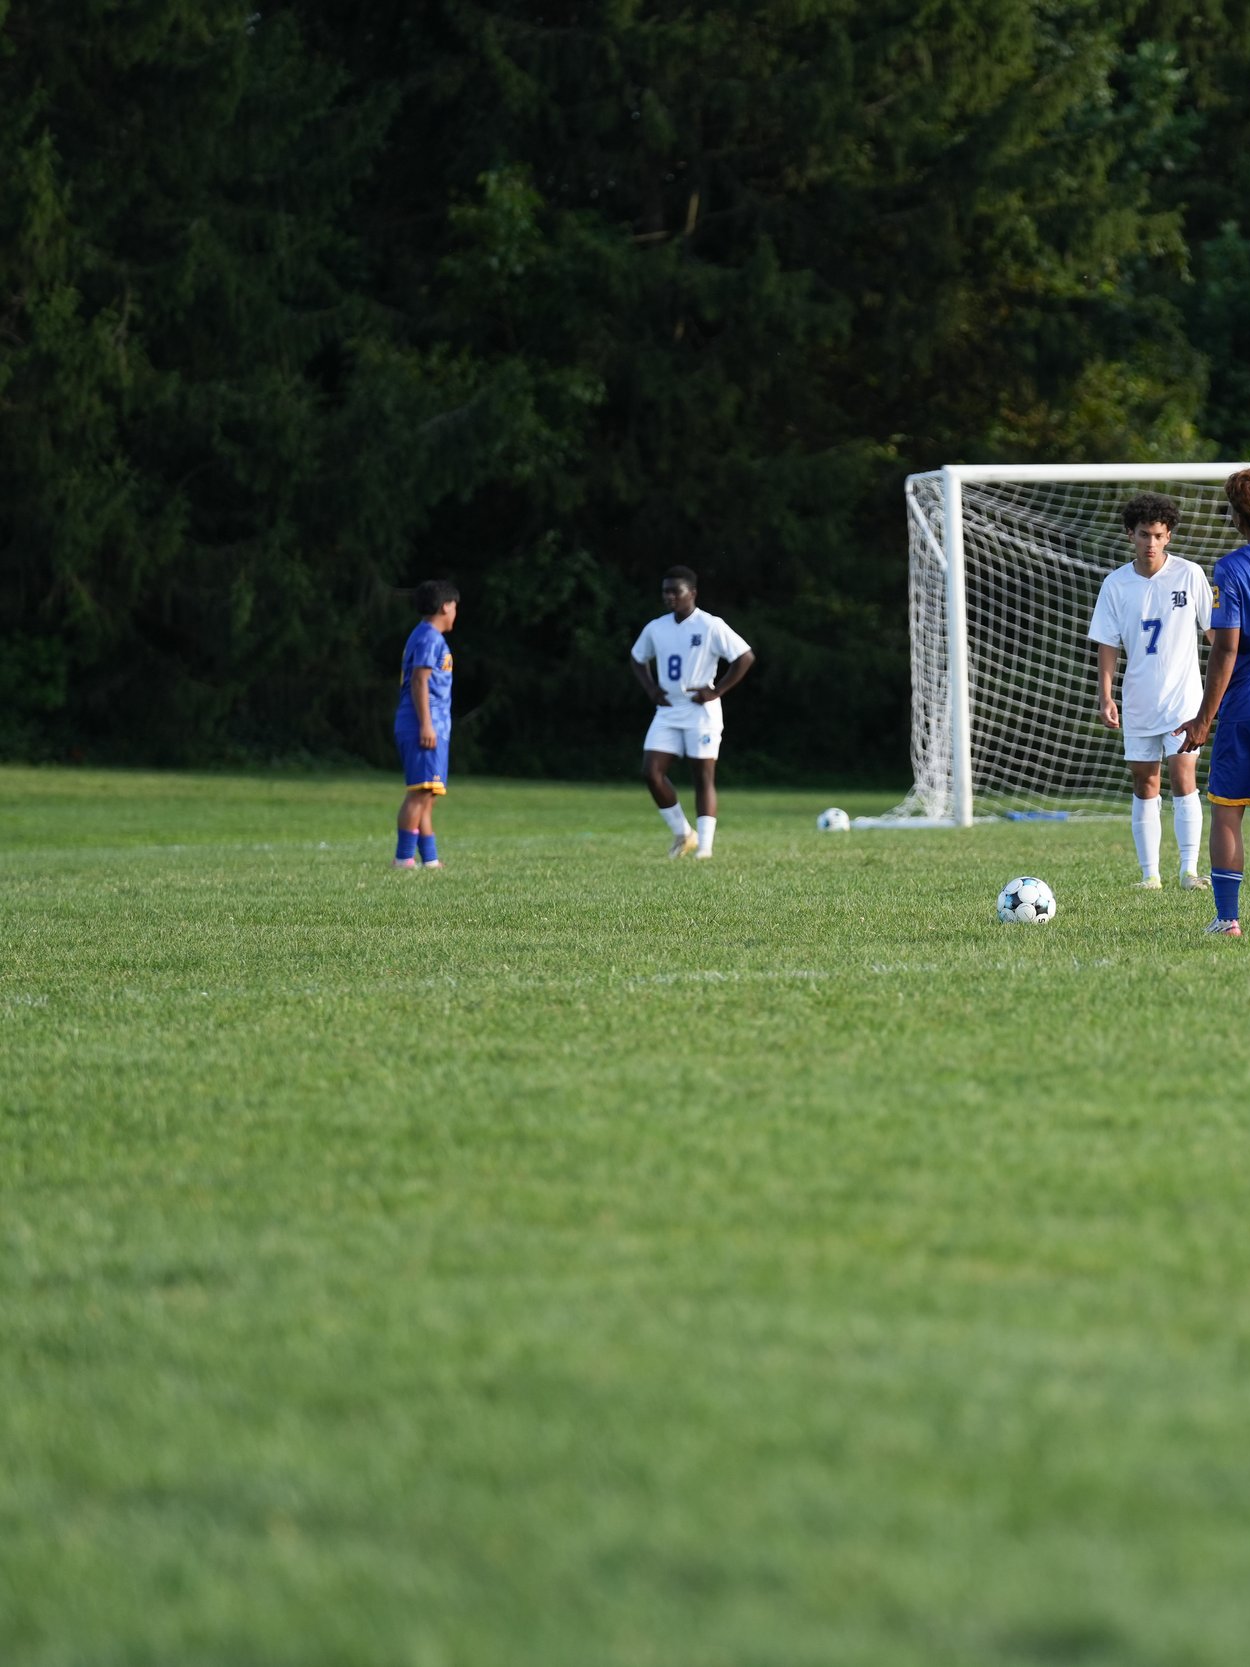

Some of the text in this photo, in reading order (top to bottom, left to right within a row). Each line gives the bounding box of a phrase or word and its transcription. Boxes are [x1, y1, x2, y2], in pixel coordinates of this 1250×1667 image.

[1171, 590, 1187, 610] B
[1141, 618, 1163, 655] 7
[668, 654, 682, 681] 8
